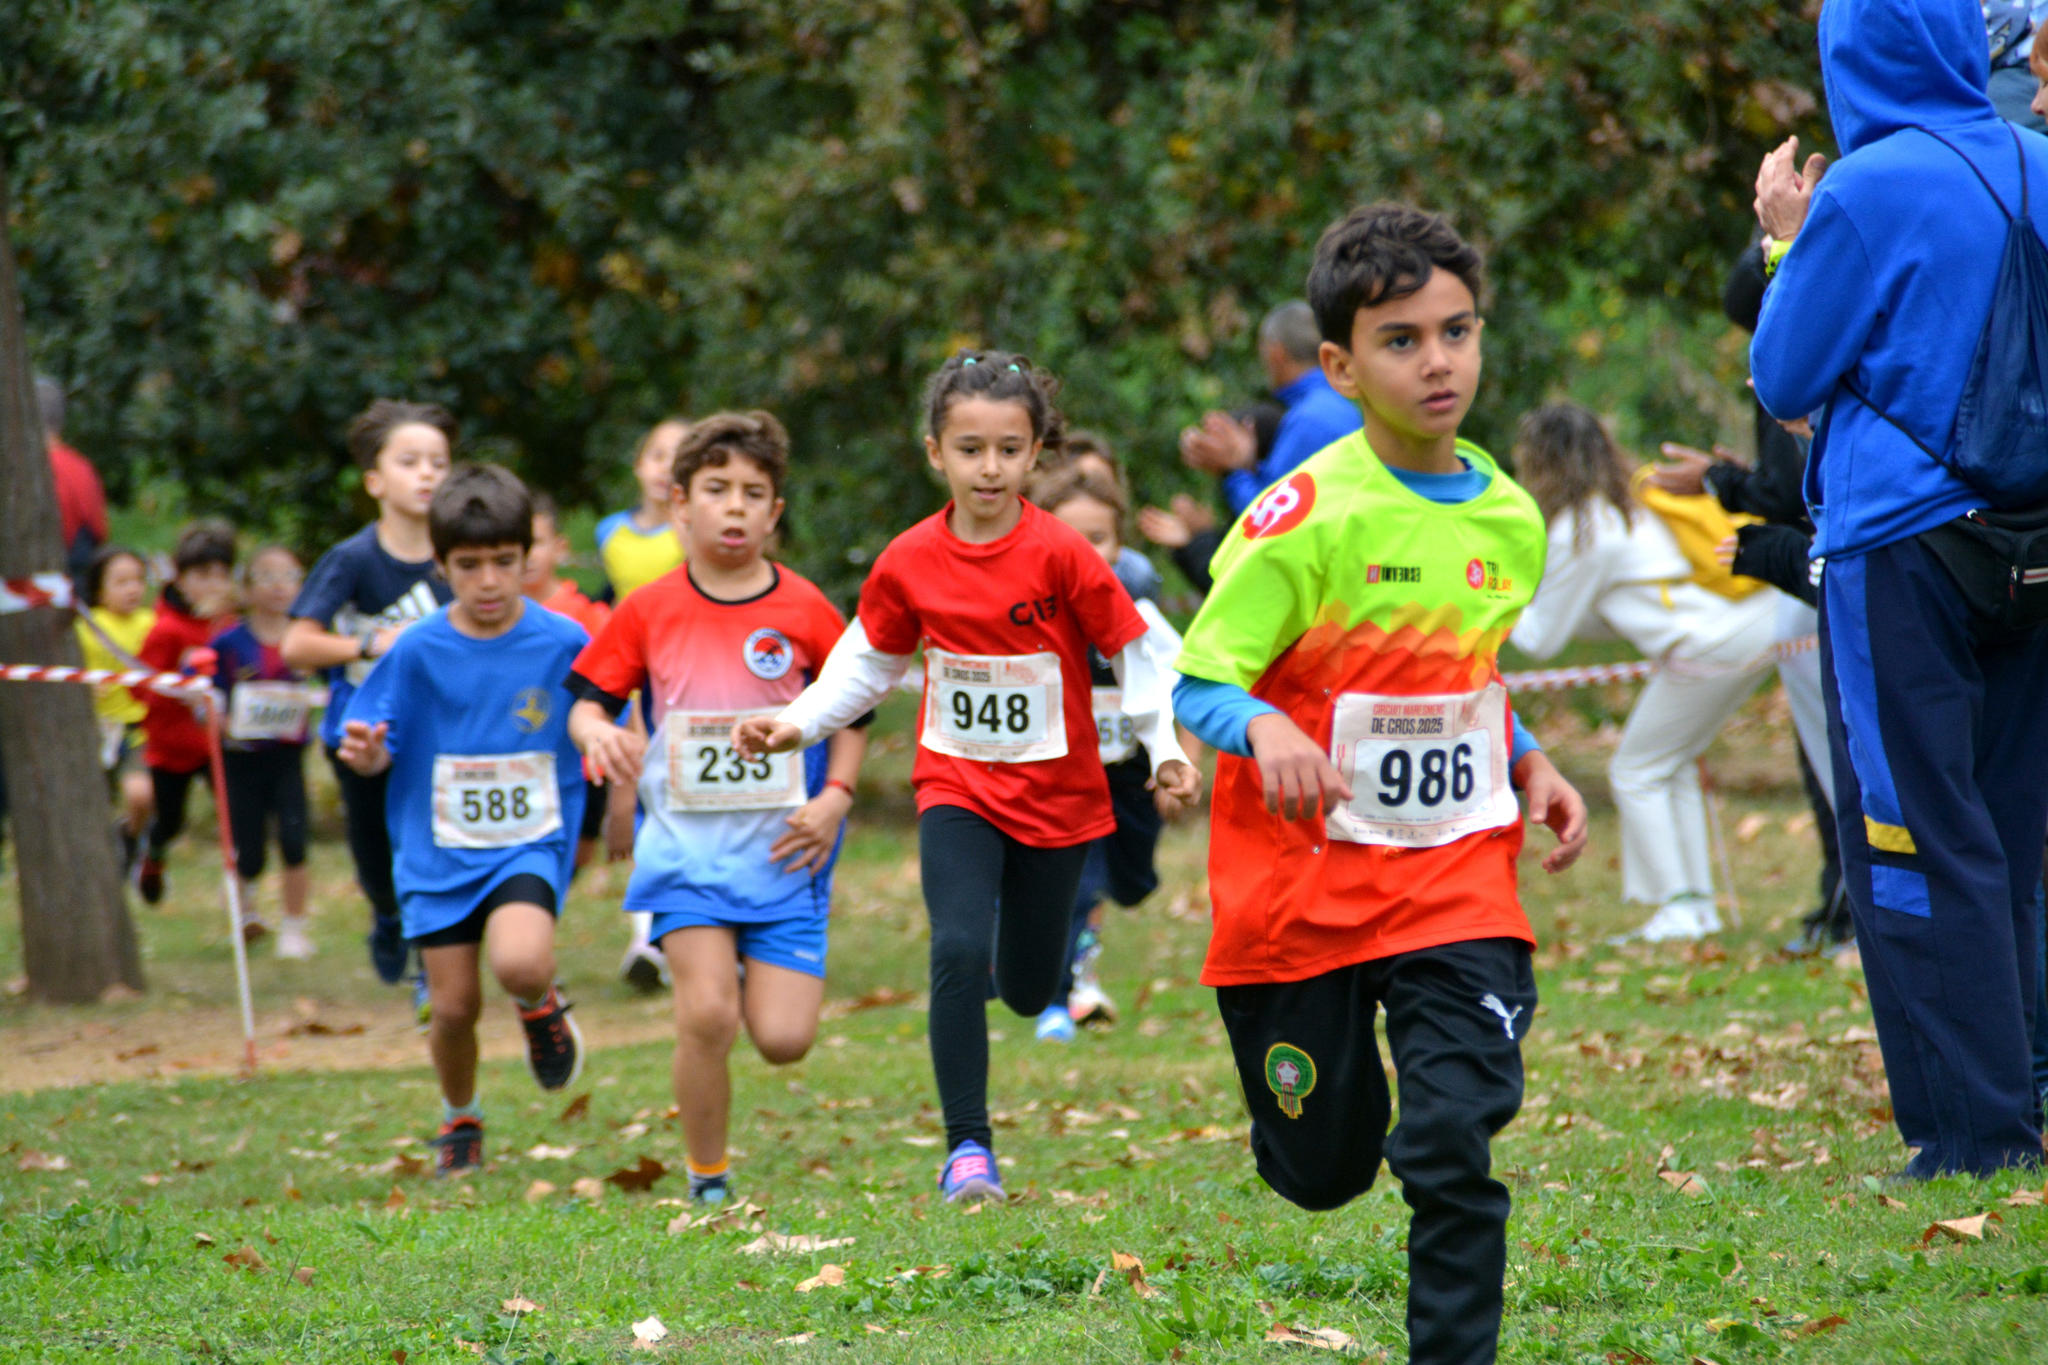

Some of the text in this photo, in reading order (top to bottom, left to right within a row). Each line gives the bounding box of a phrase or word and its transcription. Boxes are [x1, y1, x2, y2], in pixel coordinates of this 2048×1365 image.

[952, 690, 1029, 733] 948
[1371, 717, 1443, 735] DE CROS 2025
[1373, 703, 1401, 716] CIRCUIT
[698, 746, 772, 782] 233
[1378, 743, 1474, 807] 986
[462, 786, 530, 823] 588
